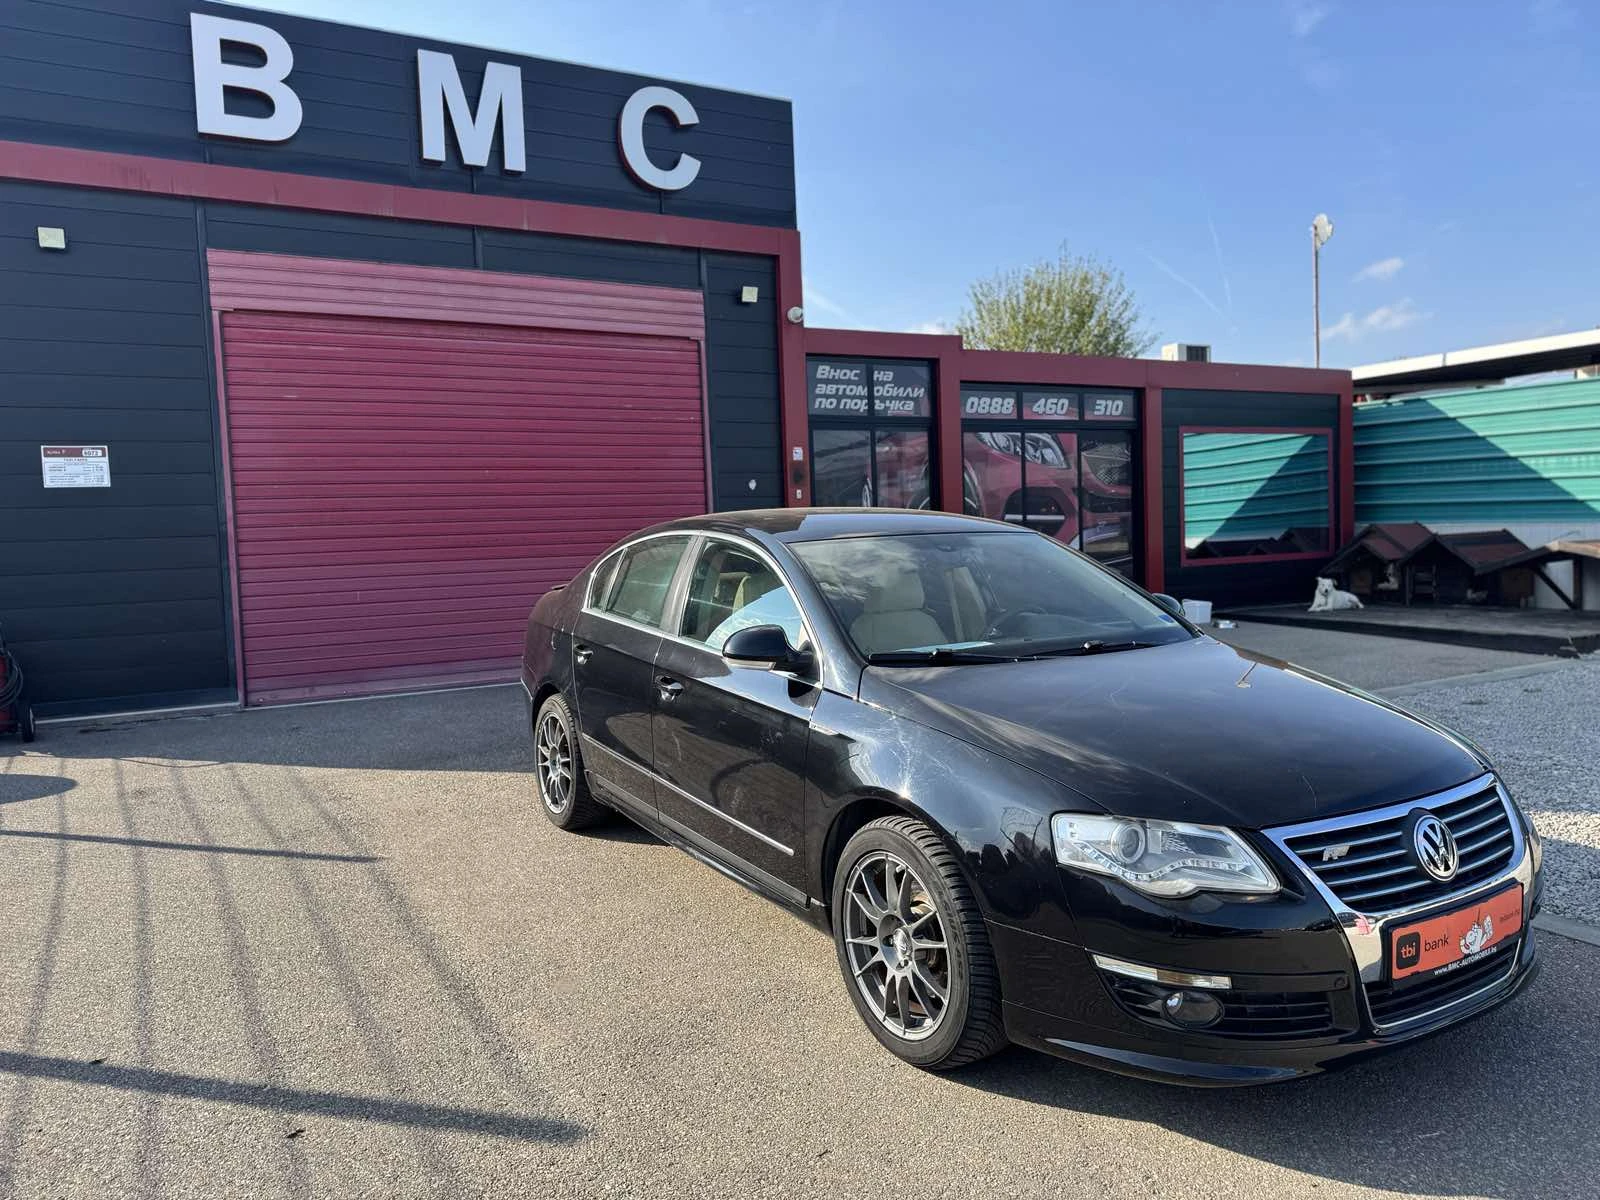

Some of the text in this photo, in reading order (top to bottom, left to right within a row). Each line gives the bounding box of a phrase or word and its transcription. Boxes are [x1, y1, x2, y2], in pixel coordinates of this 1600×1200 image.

[816, 365, 894, 382] Внос на
[814, 398, 837, 409] по
[966, 397, 1124, 416] 0888 460 310
[1400, 934, 1449, 959] tbi bank
